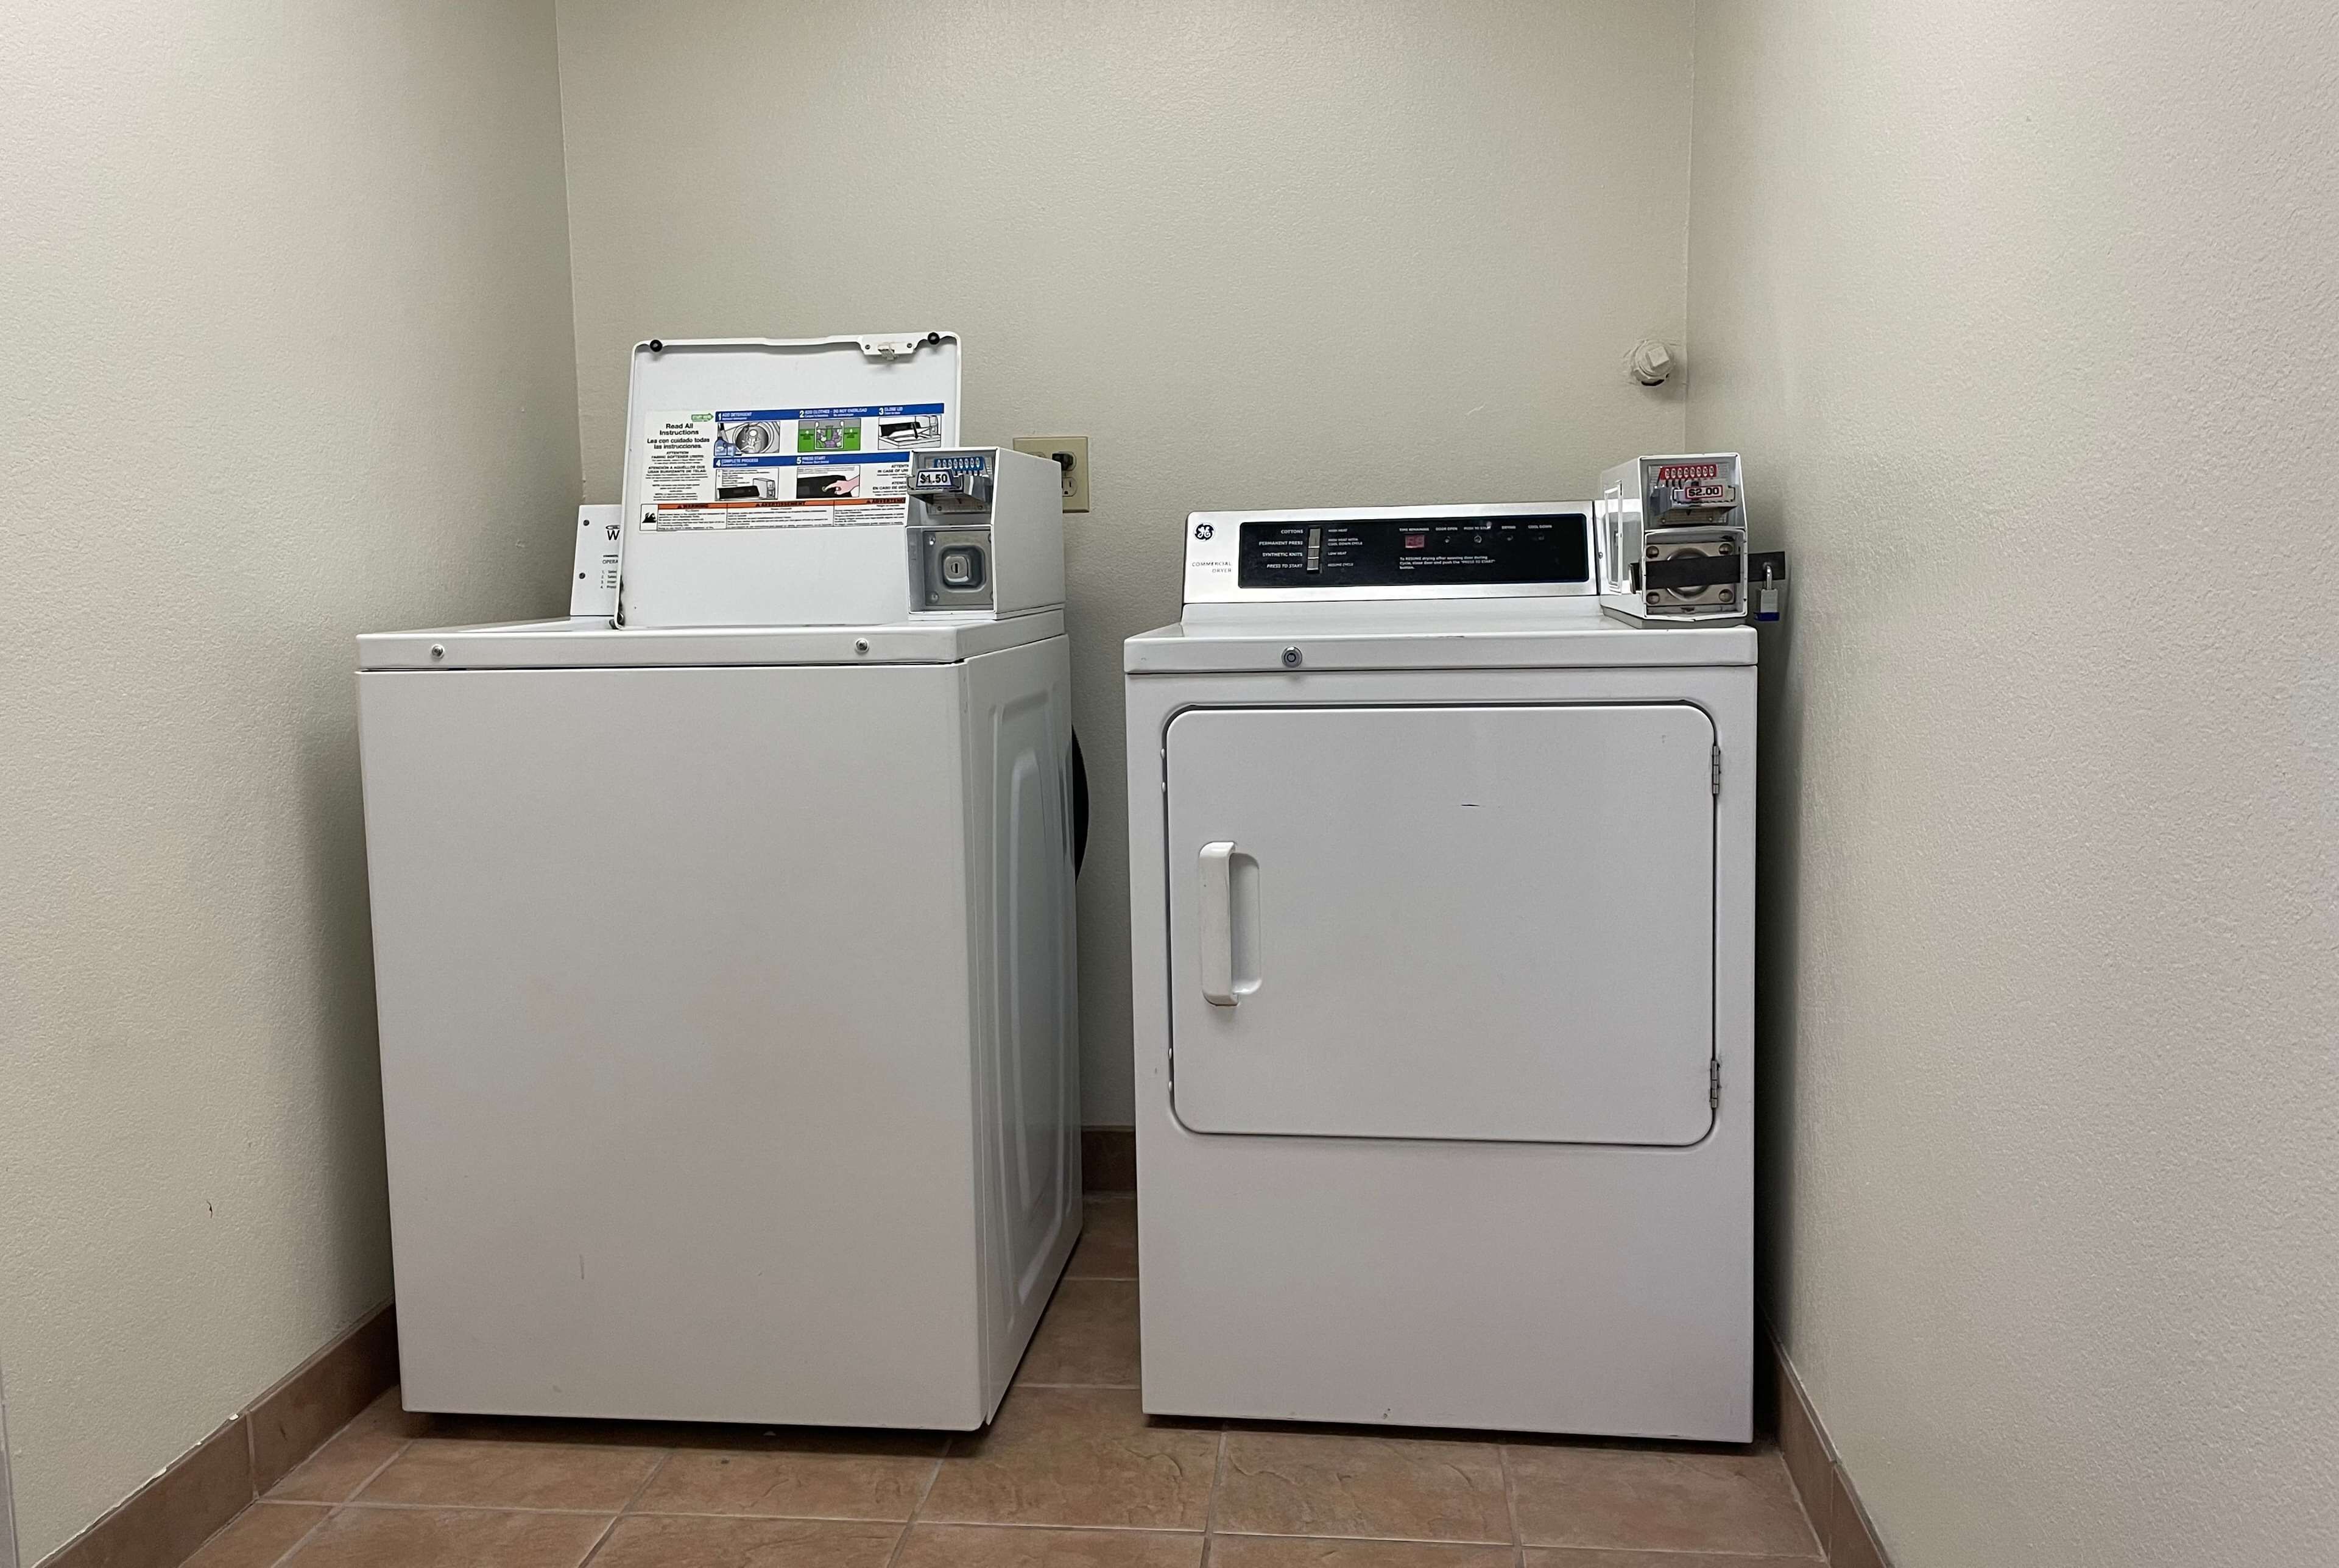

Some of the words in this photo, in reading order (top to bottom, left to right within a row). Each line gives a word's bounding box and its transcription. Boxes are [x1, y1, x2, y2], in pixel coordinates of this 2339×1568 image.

[920, 473, 948, 484] $1.50
[1688, 487, 1719, 496] $2.00
[1194, 523, 1215, 541] GE
